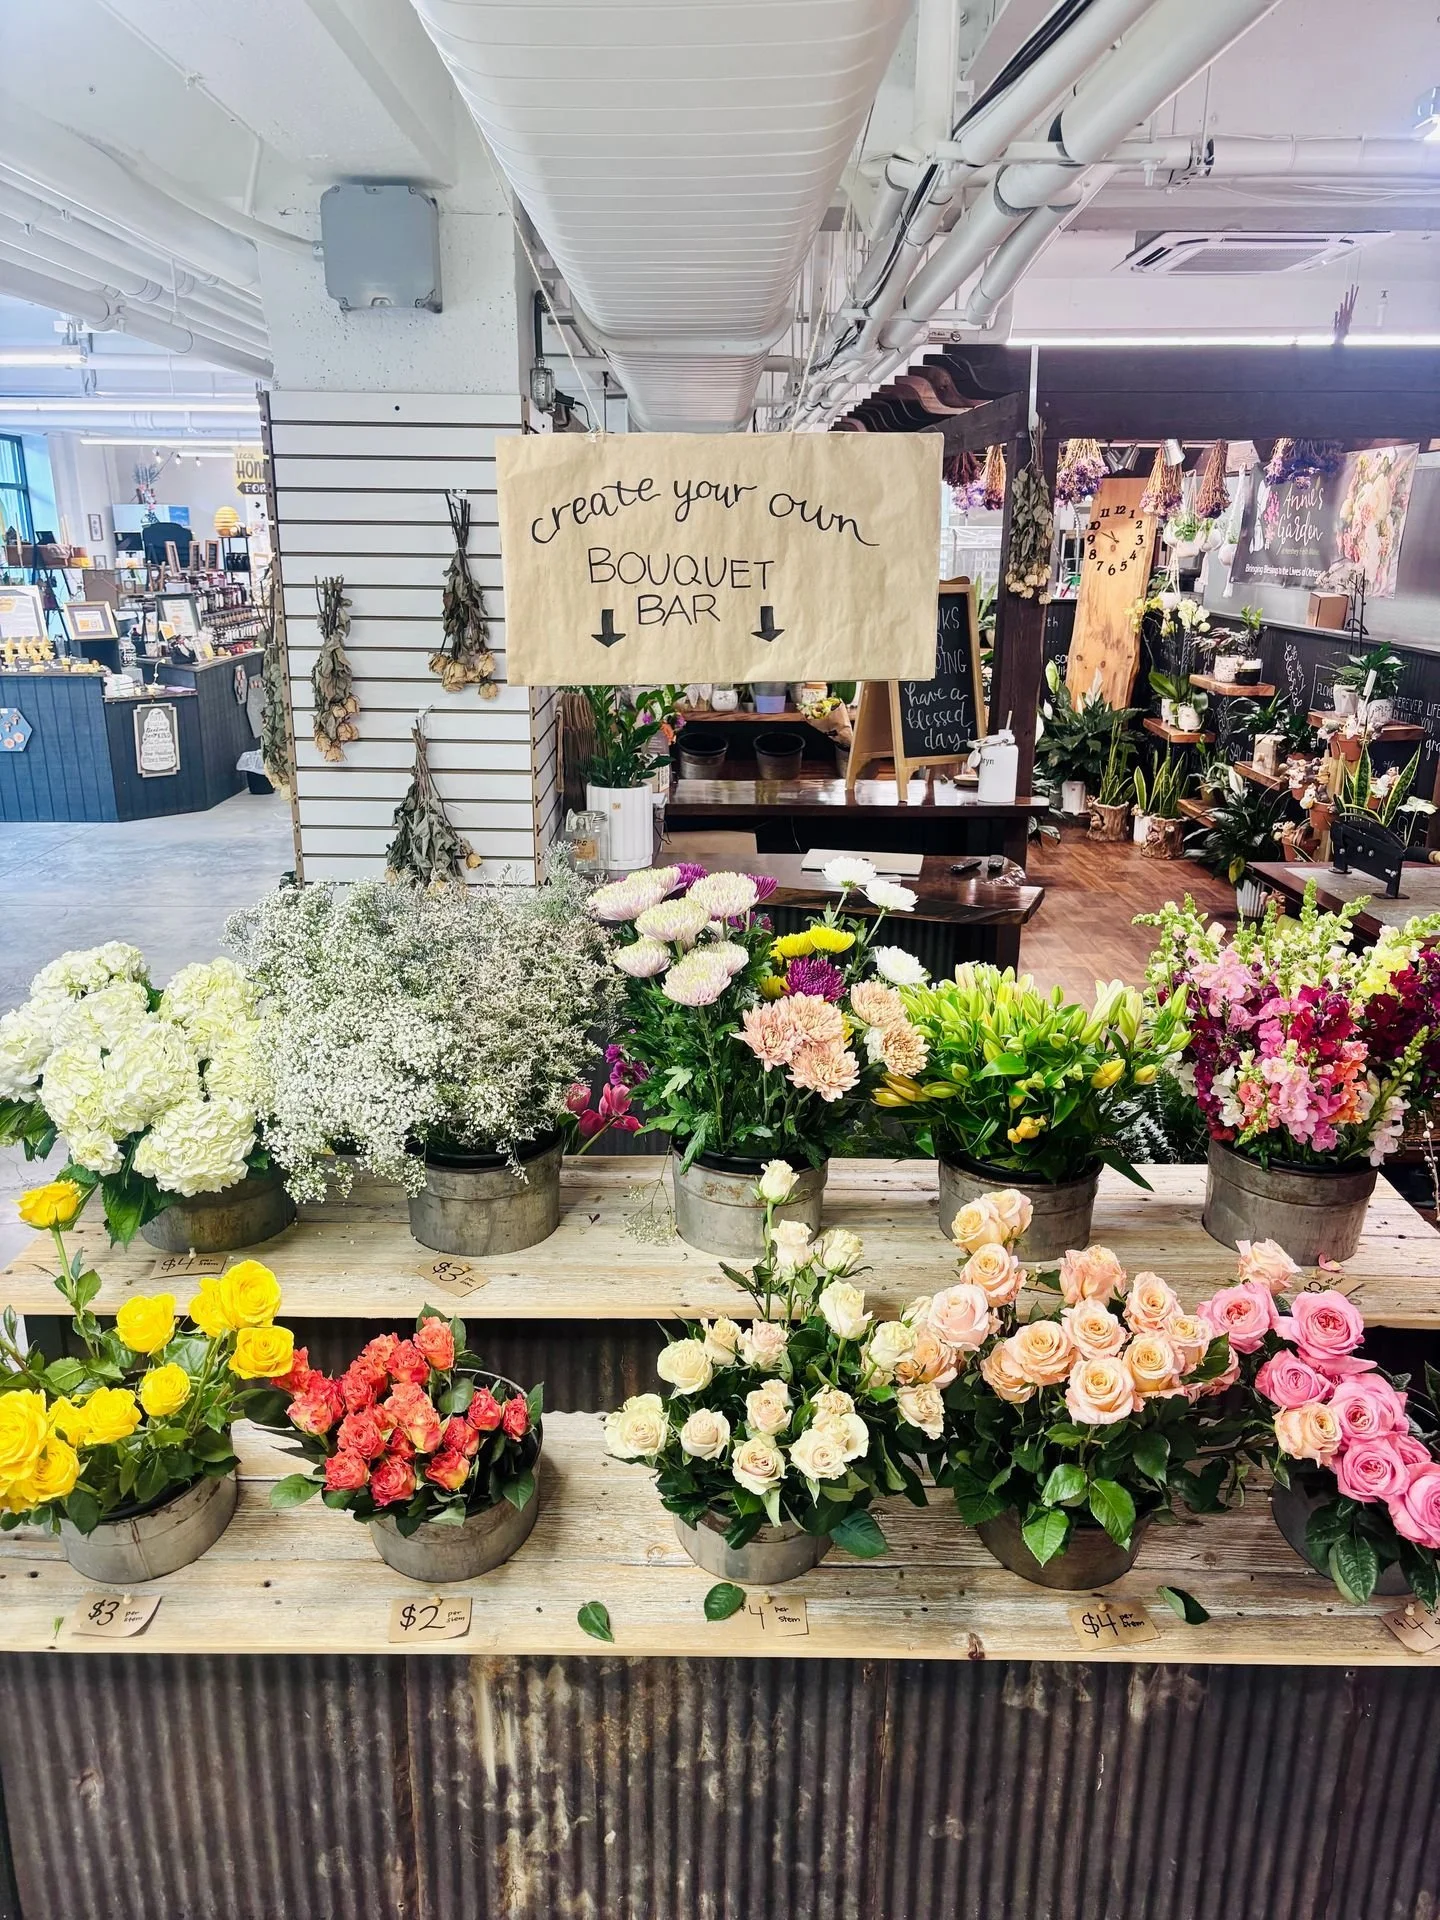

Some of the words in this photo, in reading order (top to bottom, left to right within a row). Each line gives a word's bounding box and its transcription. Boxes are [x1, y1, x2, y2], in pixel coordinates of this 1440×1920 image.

[1283, 482, 1324, 519] Annie's
[531, 477, 661, 544] create
[673, 480, 757, 522] your
[769, 493, 880, 546] own
[1100, 508, 1110, 518] 11
[1114, 505, 1126, 515] 12
[1128, 509, 1135, 519] 1
[1088, 520, 1101, 531] 10
[1135, 520, 1143, 529] 2
[1277, 511, 1323, 551] Garden
[1087, 534, 1095, 545] 9
[1135, 534, 1144, 546] 3
[1088, 549, 1097, 560] 8
[1129, 550, 1137, 560] 4
[588, 547, 775, 590] BOUQUET
[1096, 560, 1104, 571] 7
[1107, 563, 1116, 576] 6
[1119, 560, 1127, 571] 5
[637, 594, 720, 626] BAR
[904, 681, 948, 708] have
[950, 687, 969, 700] a
[906, 702, 974, 730] blessed
[924, 728, 972, 752] day!
[161, 1258, 194, 1272] $4
[88, 1599, 120, 1626] $3
[400, 1603, 446, 1631] $2
[447, 1610, 462, 1618] per
[1119, 1613, 1134, 1622] per
[1082, 1612, 1119, 1638] $4
